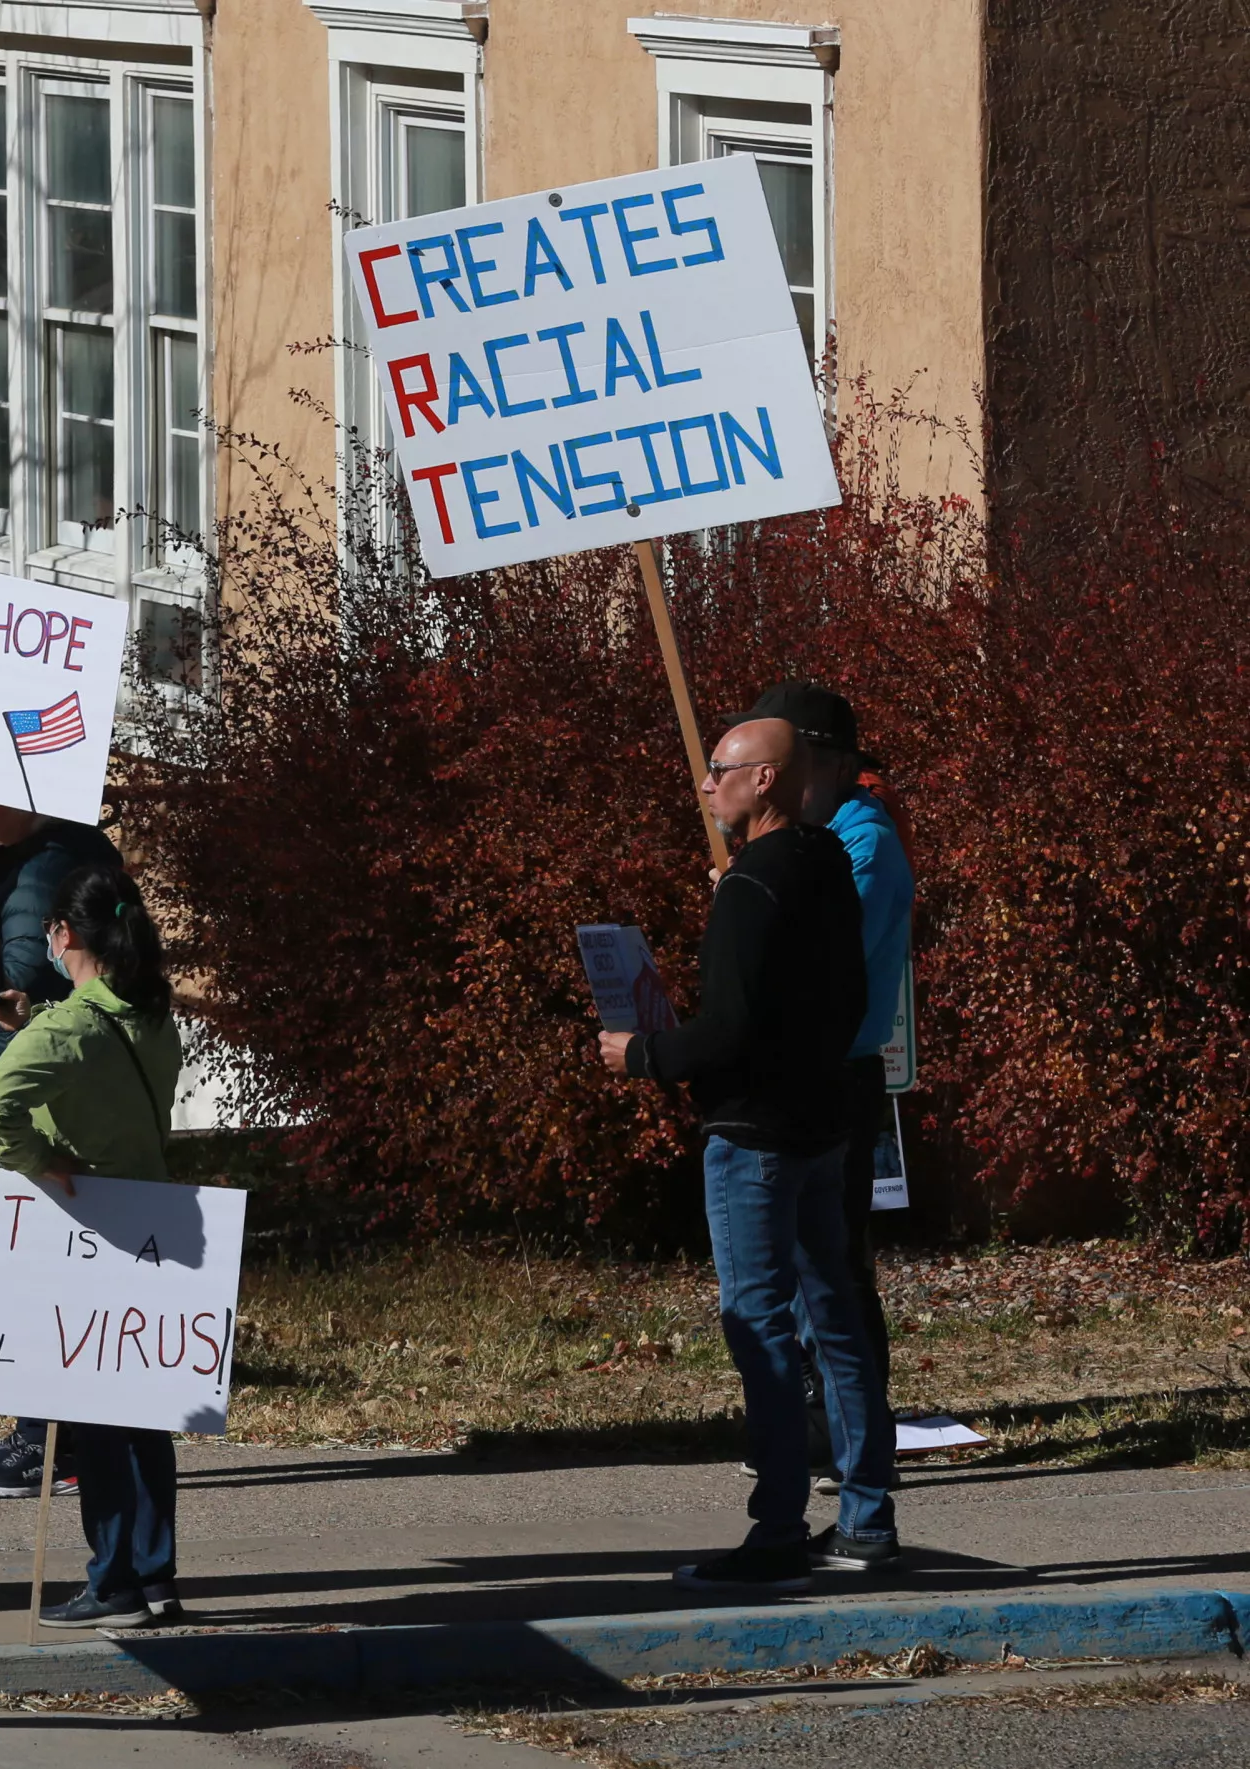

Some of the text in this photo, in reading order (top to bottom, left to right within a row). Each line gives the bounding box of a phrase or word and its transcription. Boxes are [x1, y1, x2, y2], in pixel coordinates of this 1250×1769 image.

[358, 183, 725, 329] CREATES
[387, 310, 702, 438] RACIAL
[412, 406, 783, 545] TENSION
[874, 1184, 904, 1194] GOVERNOR
[67, 1230, 98, 1259] IS
[135, 1234, 160, 1267] A
[55, 1304, 232, 1396] VIRUS!
